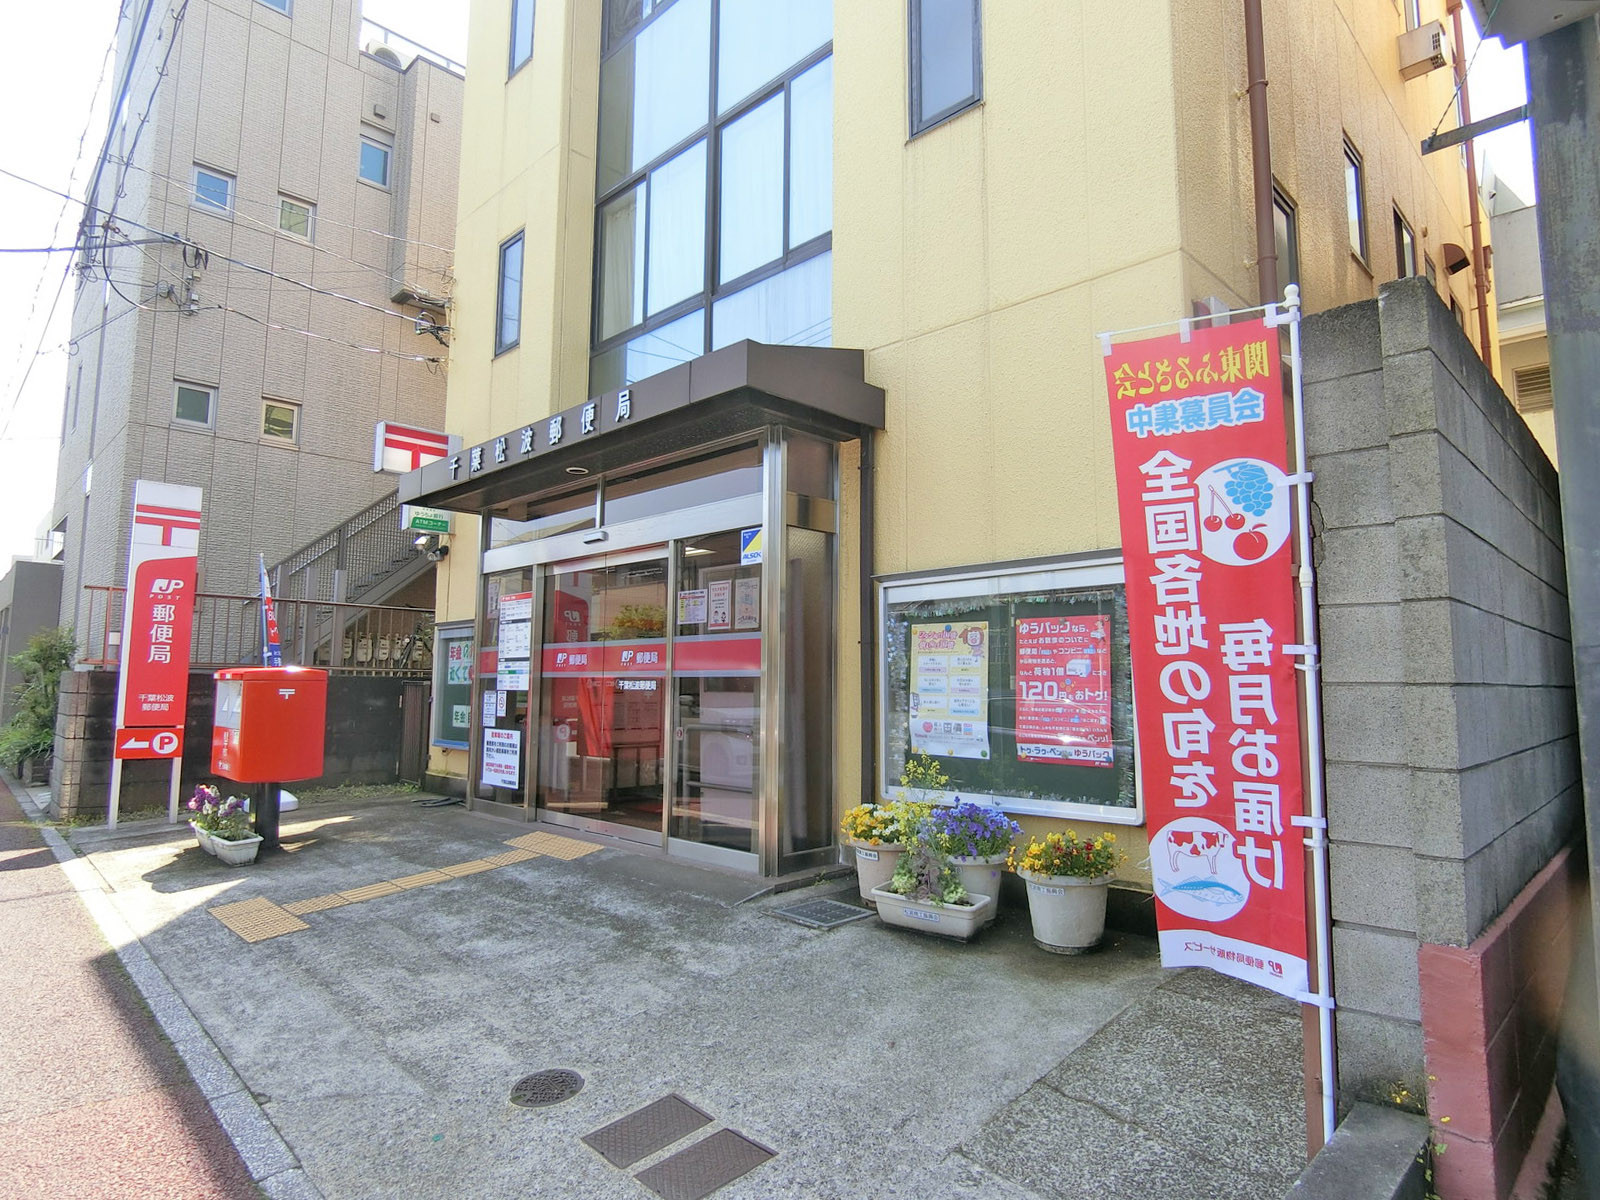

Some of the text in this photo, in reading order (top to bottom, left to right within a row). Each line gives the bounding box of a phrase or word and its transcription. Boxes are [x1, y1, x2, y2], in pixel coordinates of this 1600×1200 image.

[449, 389, 632, 480] 千葉松波郵便局
[414, 511, 444, 520] ゆうちょ銀行
[415, 519, 446, 527] ATMコーナー
[148, 604, 175, 664] 郵便局
[1019, 622, 1089, 635] ゆうパックなら、
[636, 652, 658, 664] 郵便局
[138, 694, 174, 702] 千葉松波
[142, 703, 169, 711] 郵便局
[159, 736, 173, 750] P
